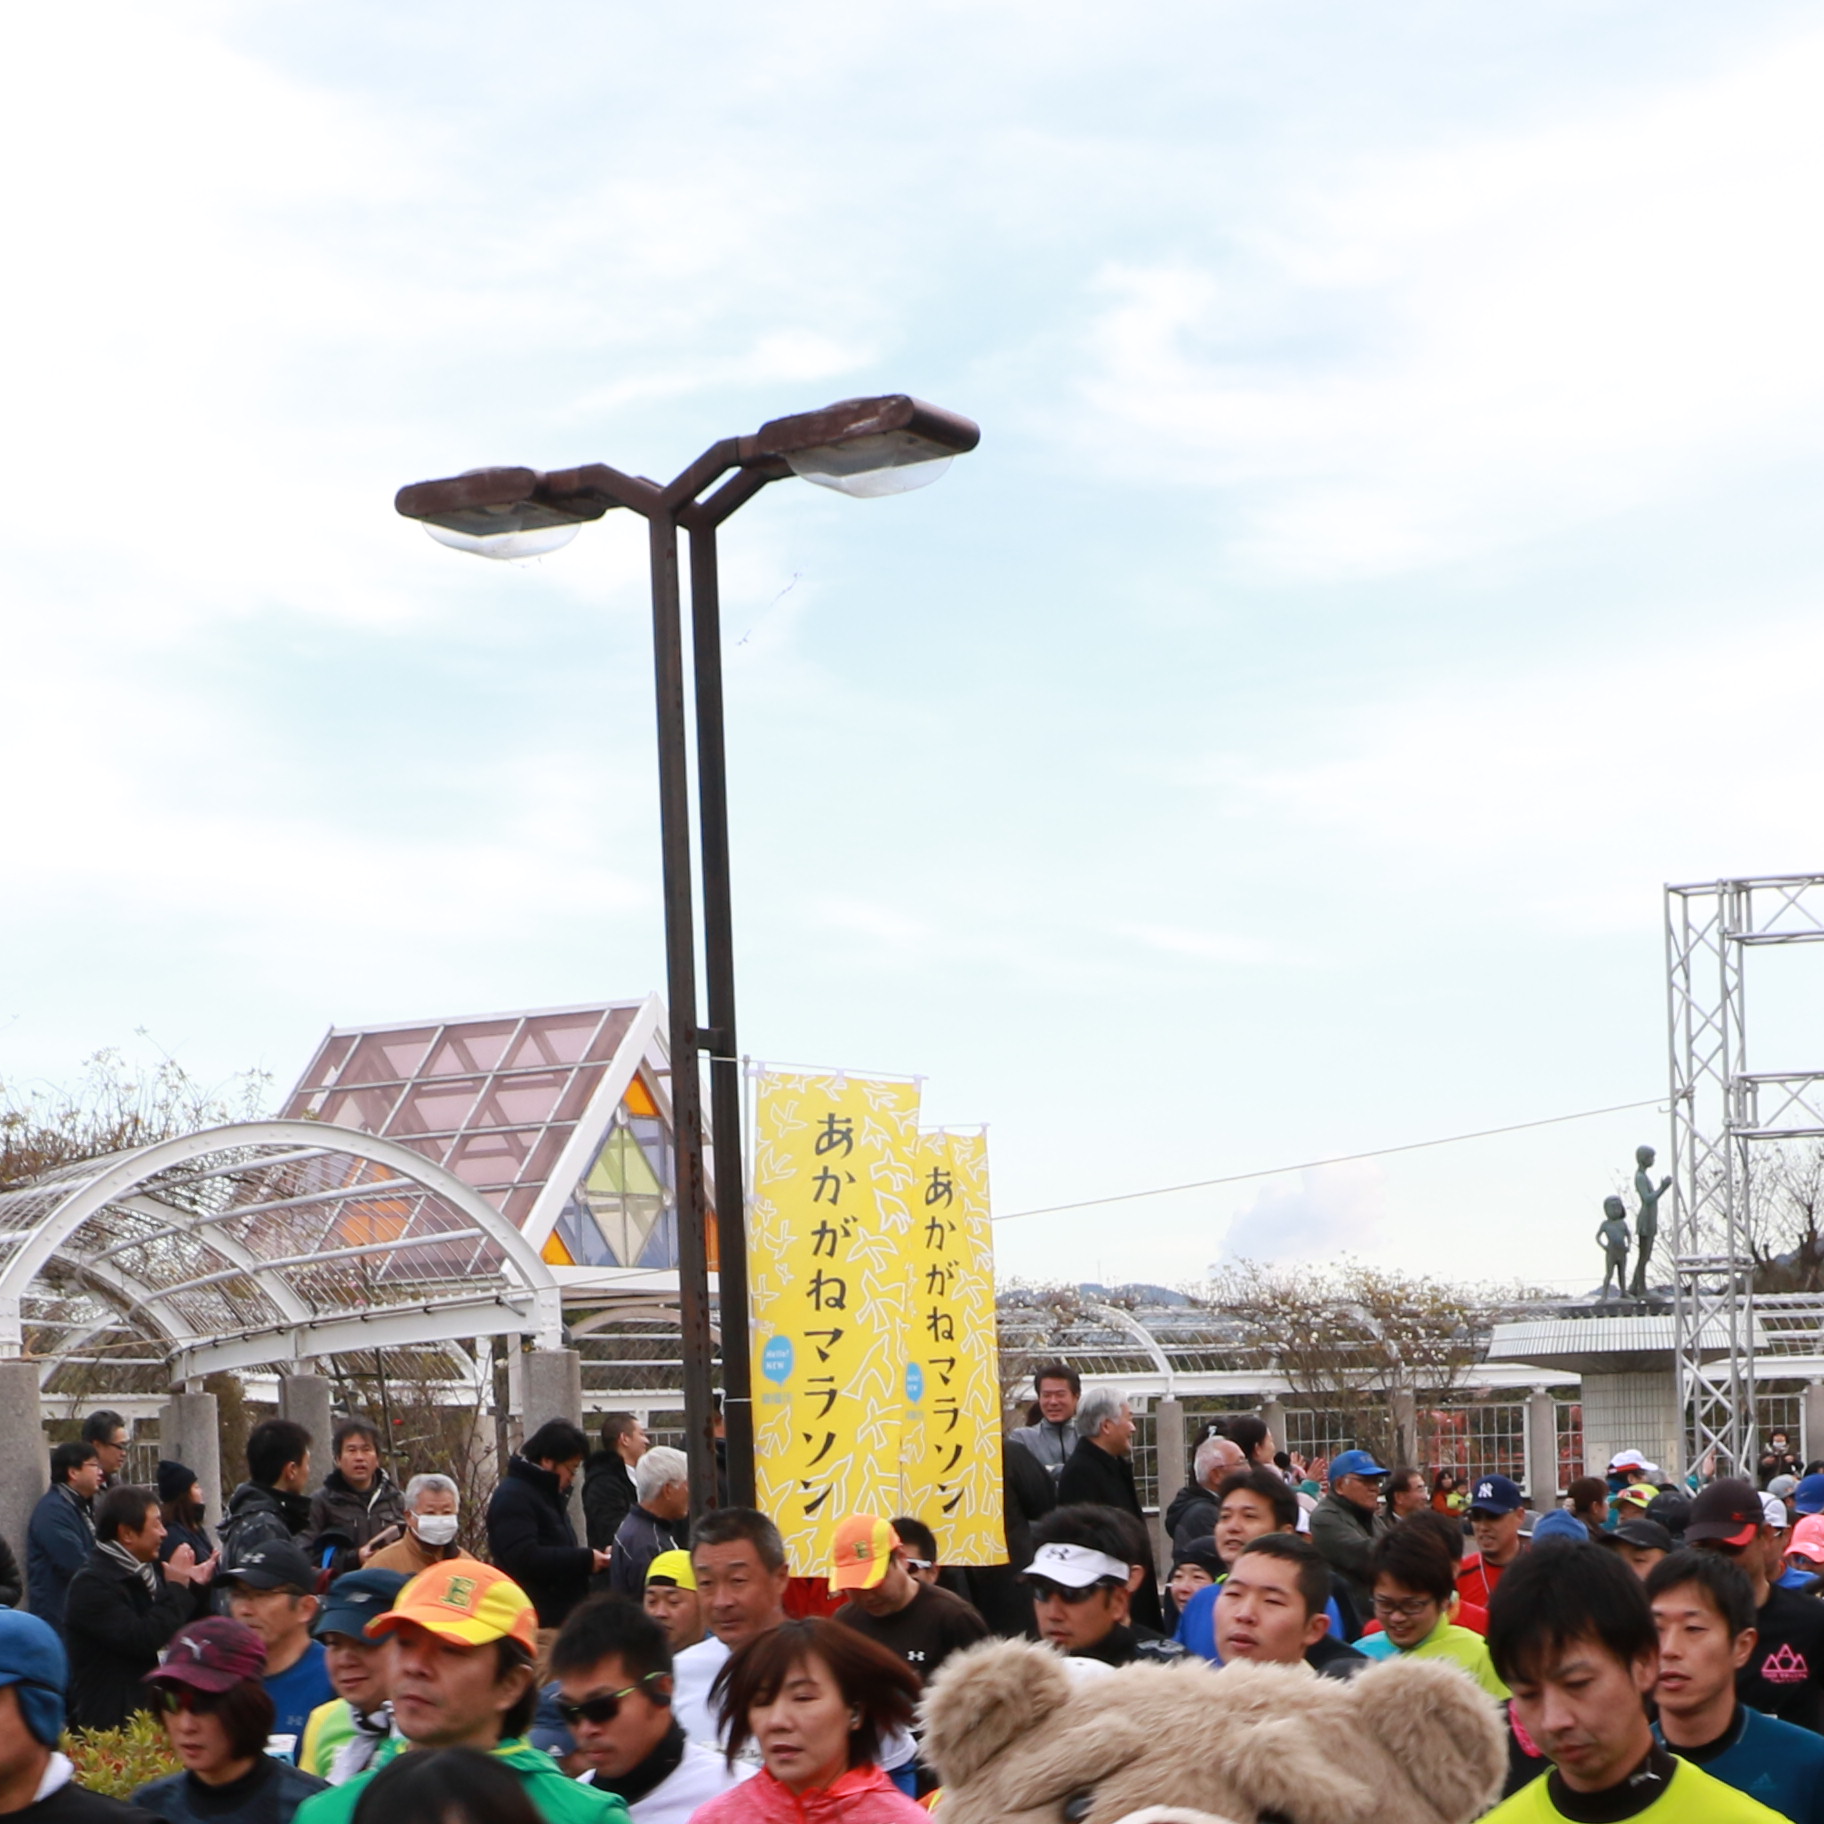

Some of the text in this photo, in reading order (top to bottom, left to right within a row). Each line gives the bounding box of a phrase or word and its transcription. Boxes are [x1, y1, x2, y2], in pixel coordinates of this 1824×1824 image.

[801, 1112, 860, 1516] あかがねマラソン
[922, 1166, 966, 1514] あかがねマラソン
